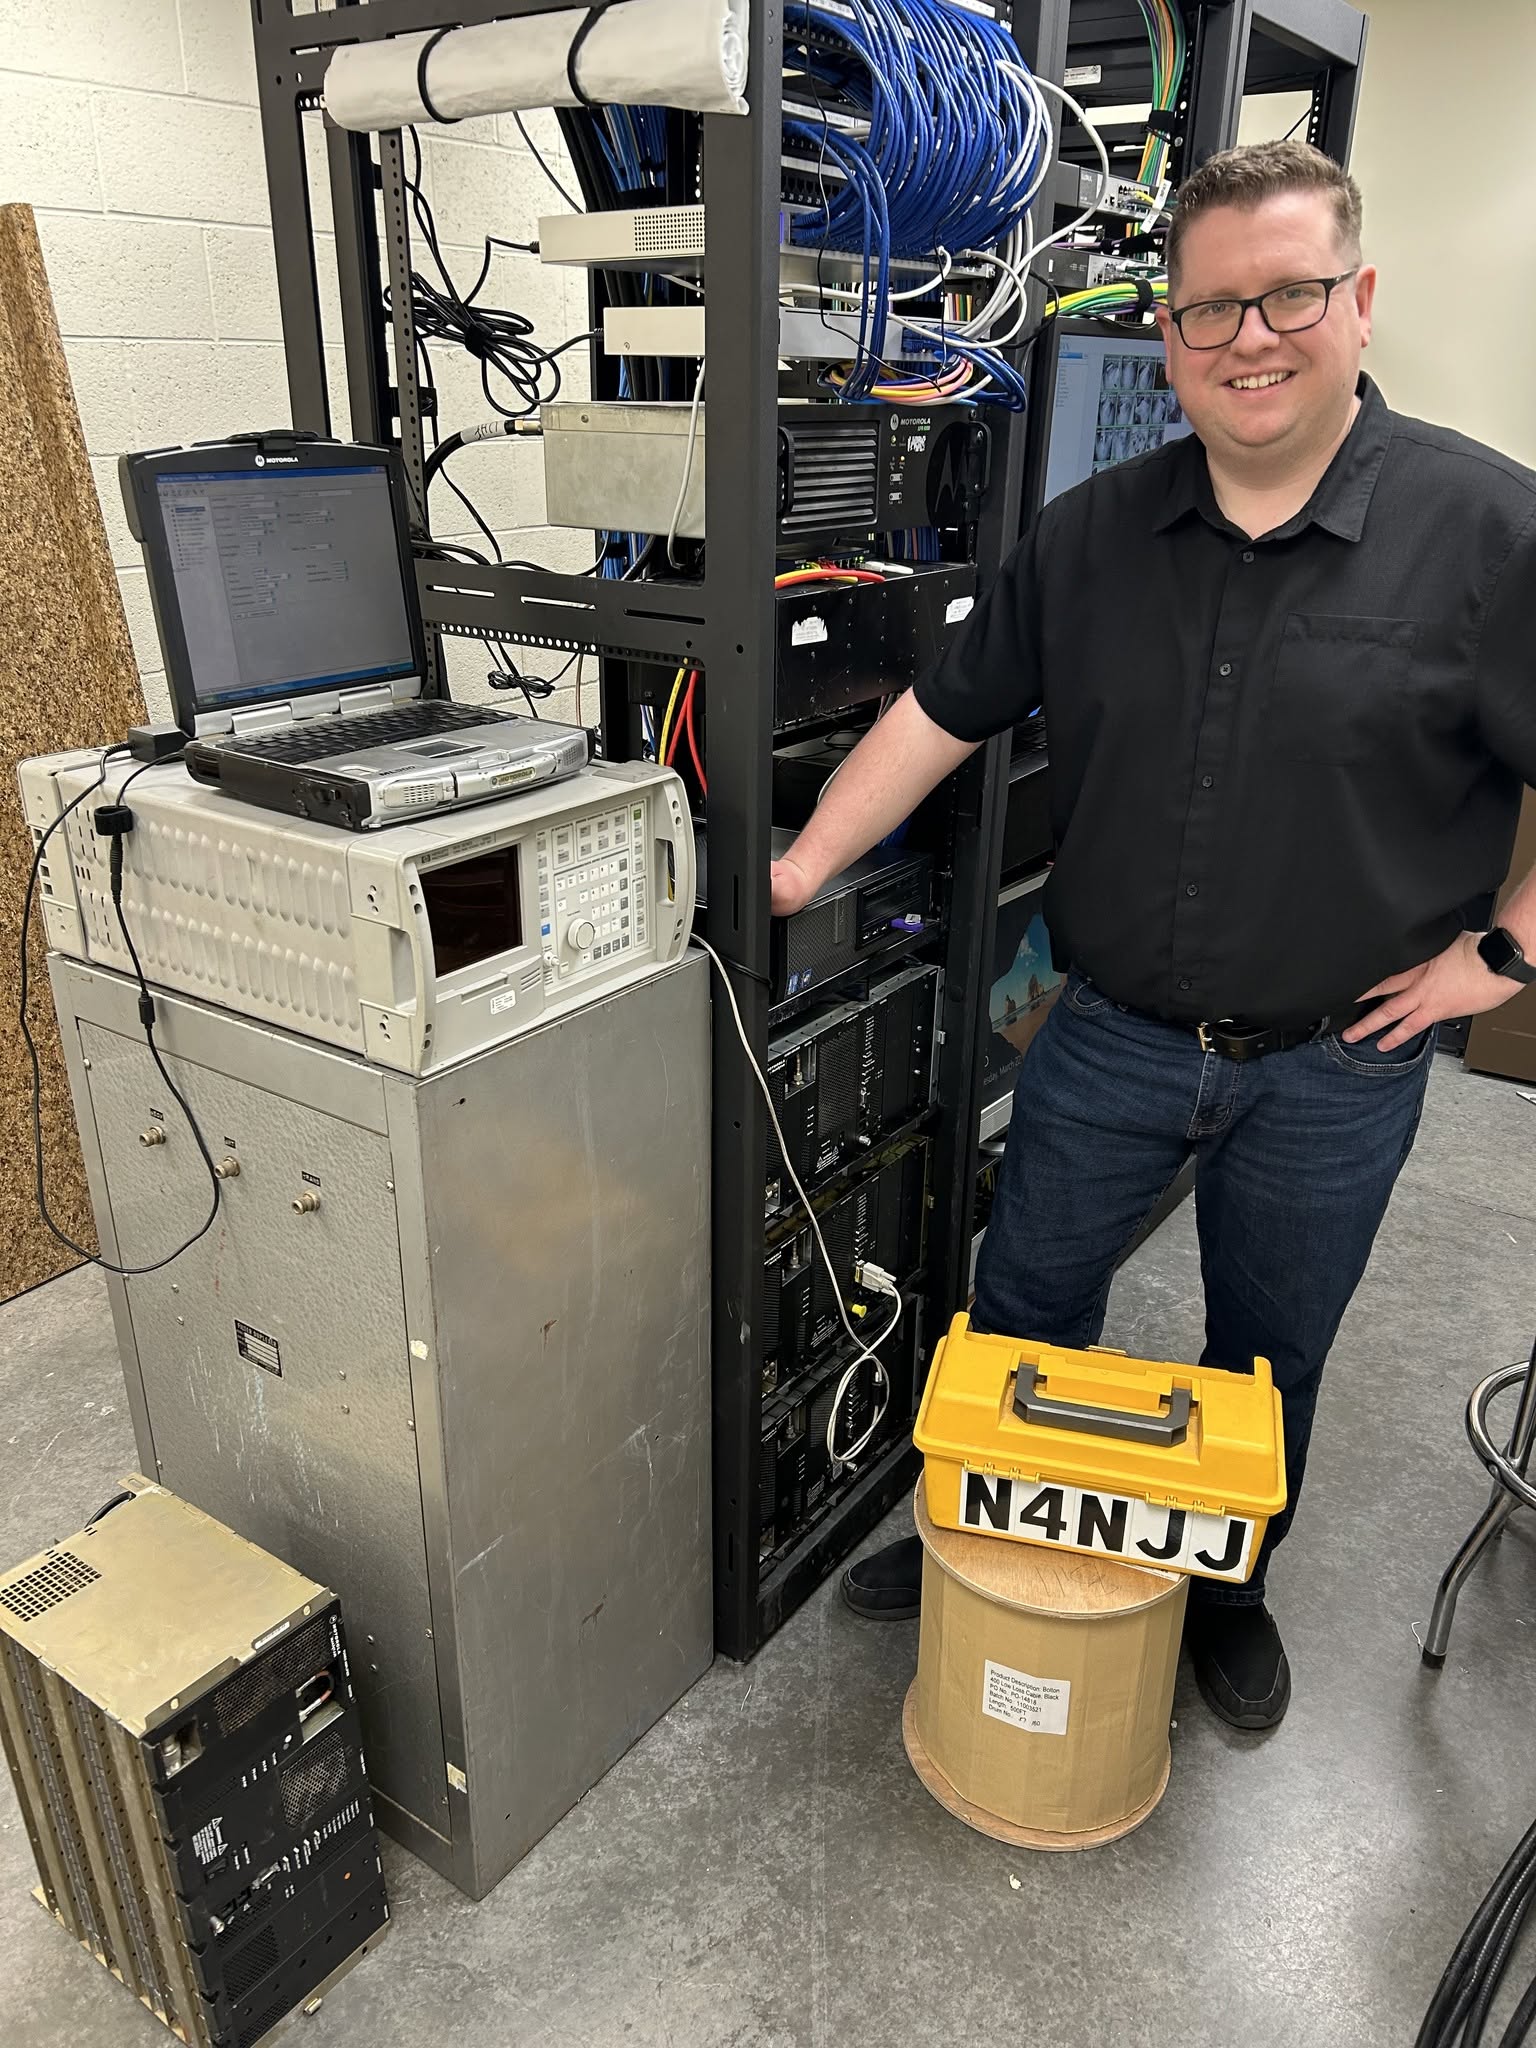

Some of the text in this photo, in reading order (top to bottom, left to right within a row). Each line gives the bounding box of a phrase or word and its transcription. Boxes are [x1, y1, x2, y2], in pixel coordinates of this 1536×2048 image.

[500, 770, 533, 782] MOTOROLA
[965, 1472, 1247, 1571] N4NJJ
[991, 1669, 1010, 1681] Product
[1011, 1678, 1040, 1691] Description:
[1001, 1680, 1011, 1689] Low
[1013, 1685, 1024, 1694] Loss
[990, 1690, 1004, 1701] Batch
[989, 1704, 1002, 1714] Drum
[1010, 1705, 1027, 1715] 500FT
